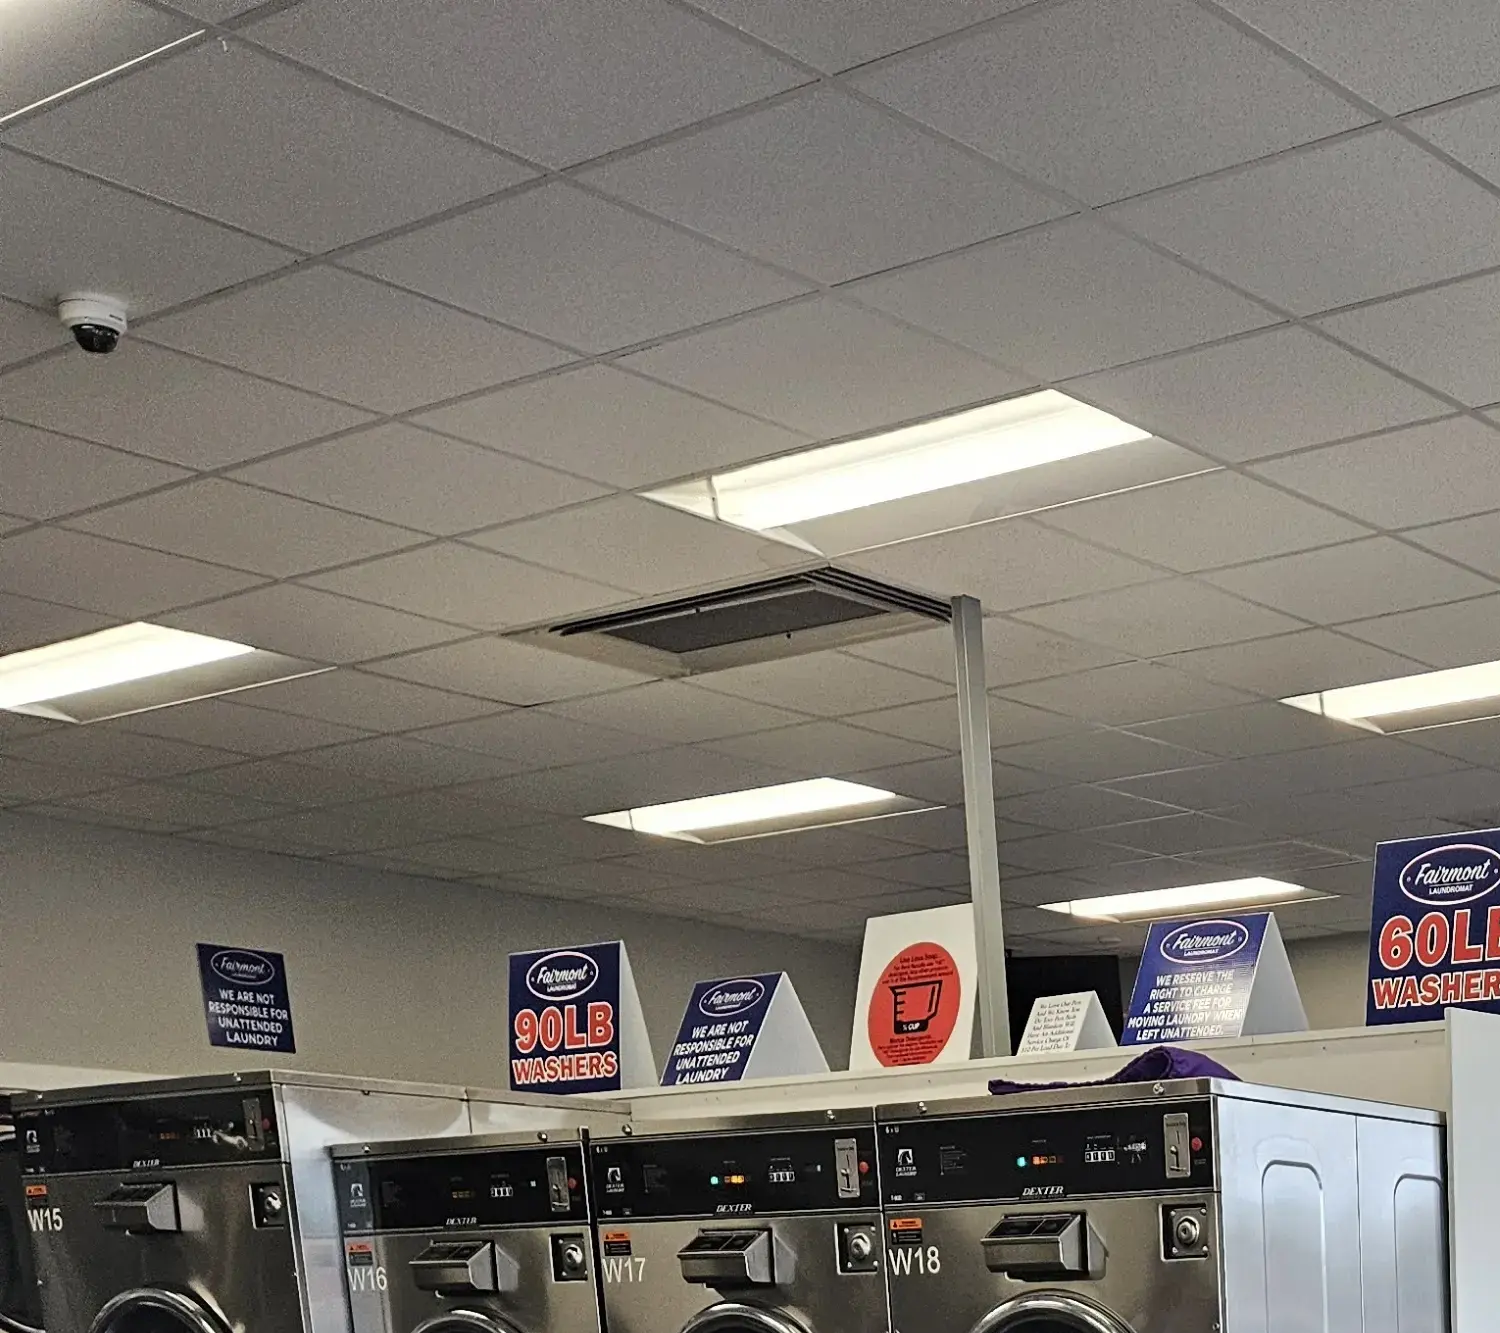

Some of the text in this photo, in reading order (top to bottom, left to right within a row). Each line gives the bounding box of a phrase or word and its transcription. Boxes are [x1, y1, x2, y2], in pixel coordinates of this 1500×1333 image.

[1414, 859, 1491, 885] Fairmont
[1429, 884, 1473, 895] LAUNDROMAT
[1172, 930, 1237, 950] Fairmont
[220, 957, 265, 974] Fairmont
[537, 963, 589, 985] Fairmont
[1156, 969, 1235, 986] WE RESERVE THE
[219, 988, 275, 1005] WE ARE NOT
[708, 987, 757, 1005] Fairmont
[1150, 983, 1233, 1000] RIGHT TO CHARGE
[208, 1001, 289, 1020] RESPONSIBLE FOR
[1143, 996, 1232, 1014] A SERVICE FEE FOR
[218, 1017, 283, 1033] UNATTENDED
[514, 1001, 614, 1053] 90LB
[1127, 1008, 1244, 1028] MOVING LAUNDRY WHEN
[226, 1031, 278, 1046] LAUNDRY
[692, 1020, 750, 1039] WE ARE NOT
[1136, 1028, 1160, 1041] LEFT
[673, 1034, 755, 1056] RESPONSIBLE FOR
[512, 1051, 618, 1085] WASHERS
[676, 1051, 741, 1071] UNATTENDED
[675, 1066, 730, 1085] LAUNDRY
[1022, 1185, 1065, 1196] DEXTER
[716, 1203, 752, 1213] DEXTER
[27, 1207, 64, 1232] W15
[446, 1216, 477, 1226] DEXTER
[602, 1257, 646, 1283] W17
[888, 1245, 941, 1276] W18
[348, 1266, 388, 1291] W16
